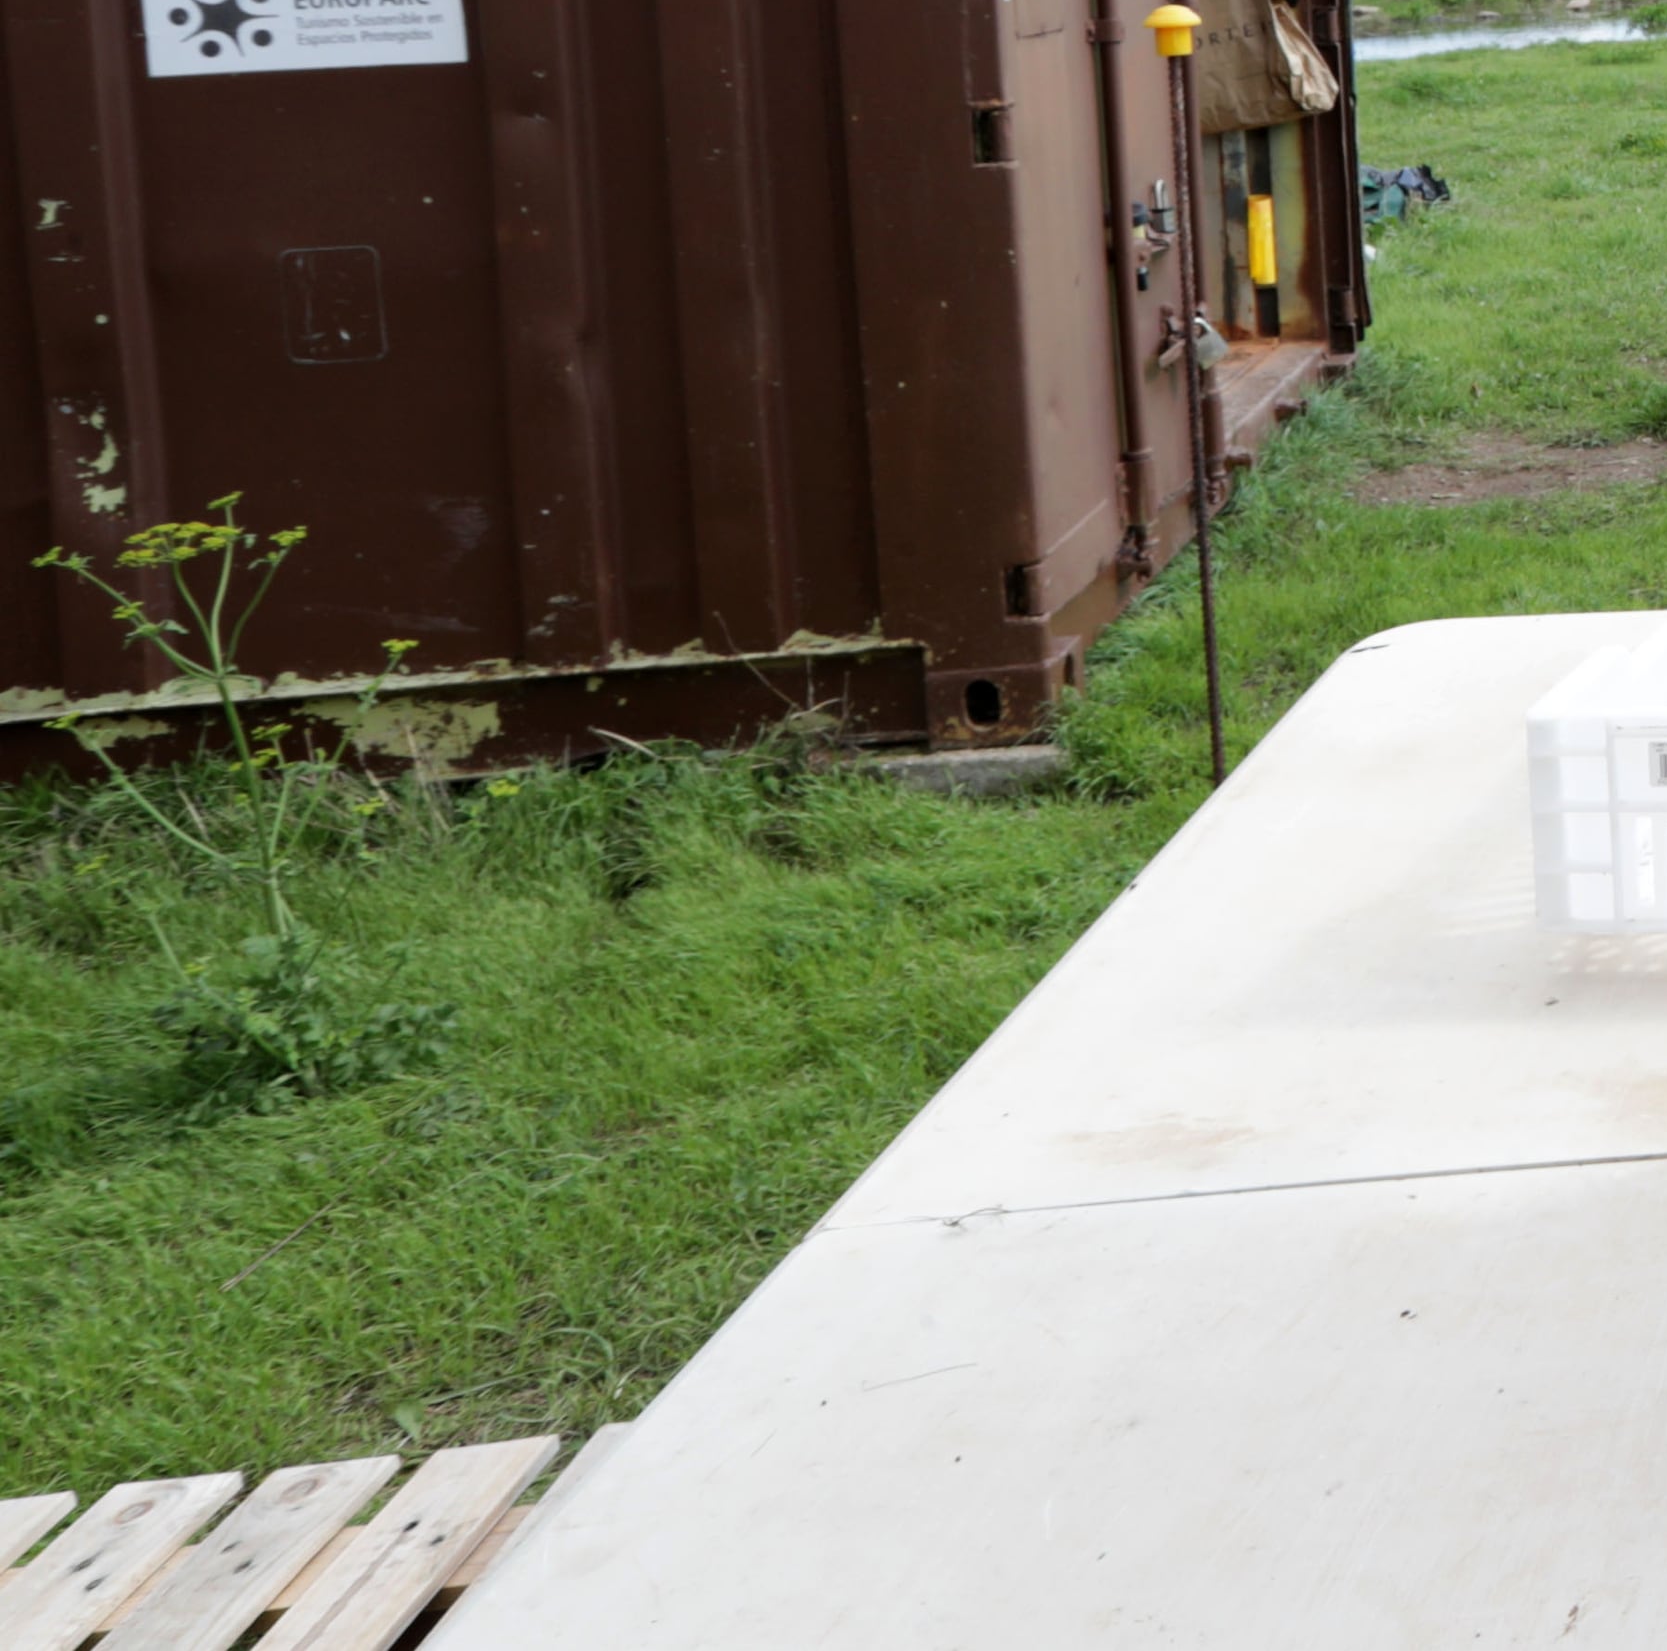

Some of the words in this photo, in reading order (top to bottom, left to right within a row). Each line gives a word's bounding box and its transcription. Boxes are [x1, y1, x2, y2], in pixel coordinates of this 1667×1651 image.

[296, 17, 349, 28] Turismo
[353, 14, 423, 26] Sostenible
[296, 35, 356, 46] Espacios
[360, 30, 433, 44] Protegidos
